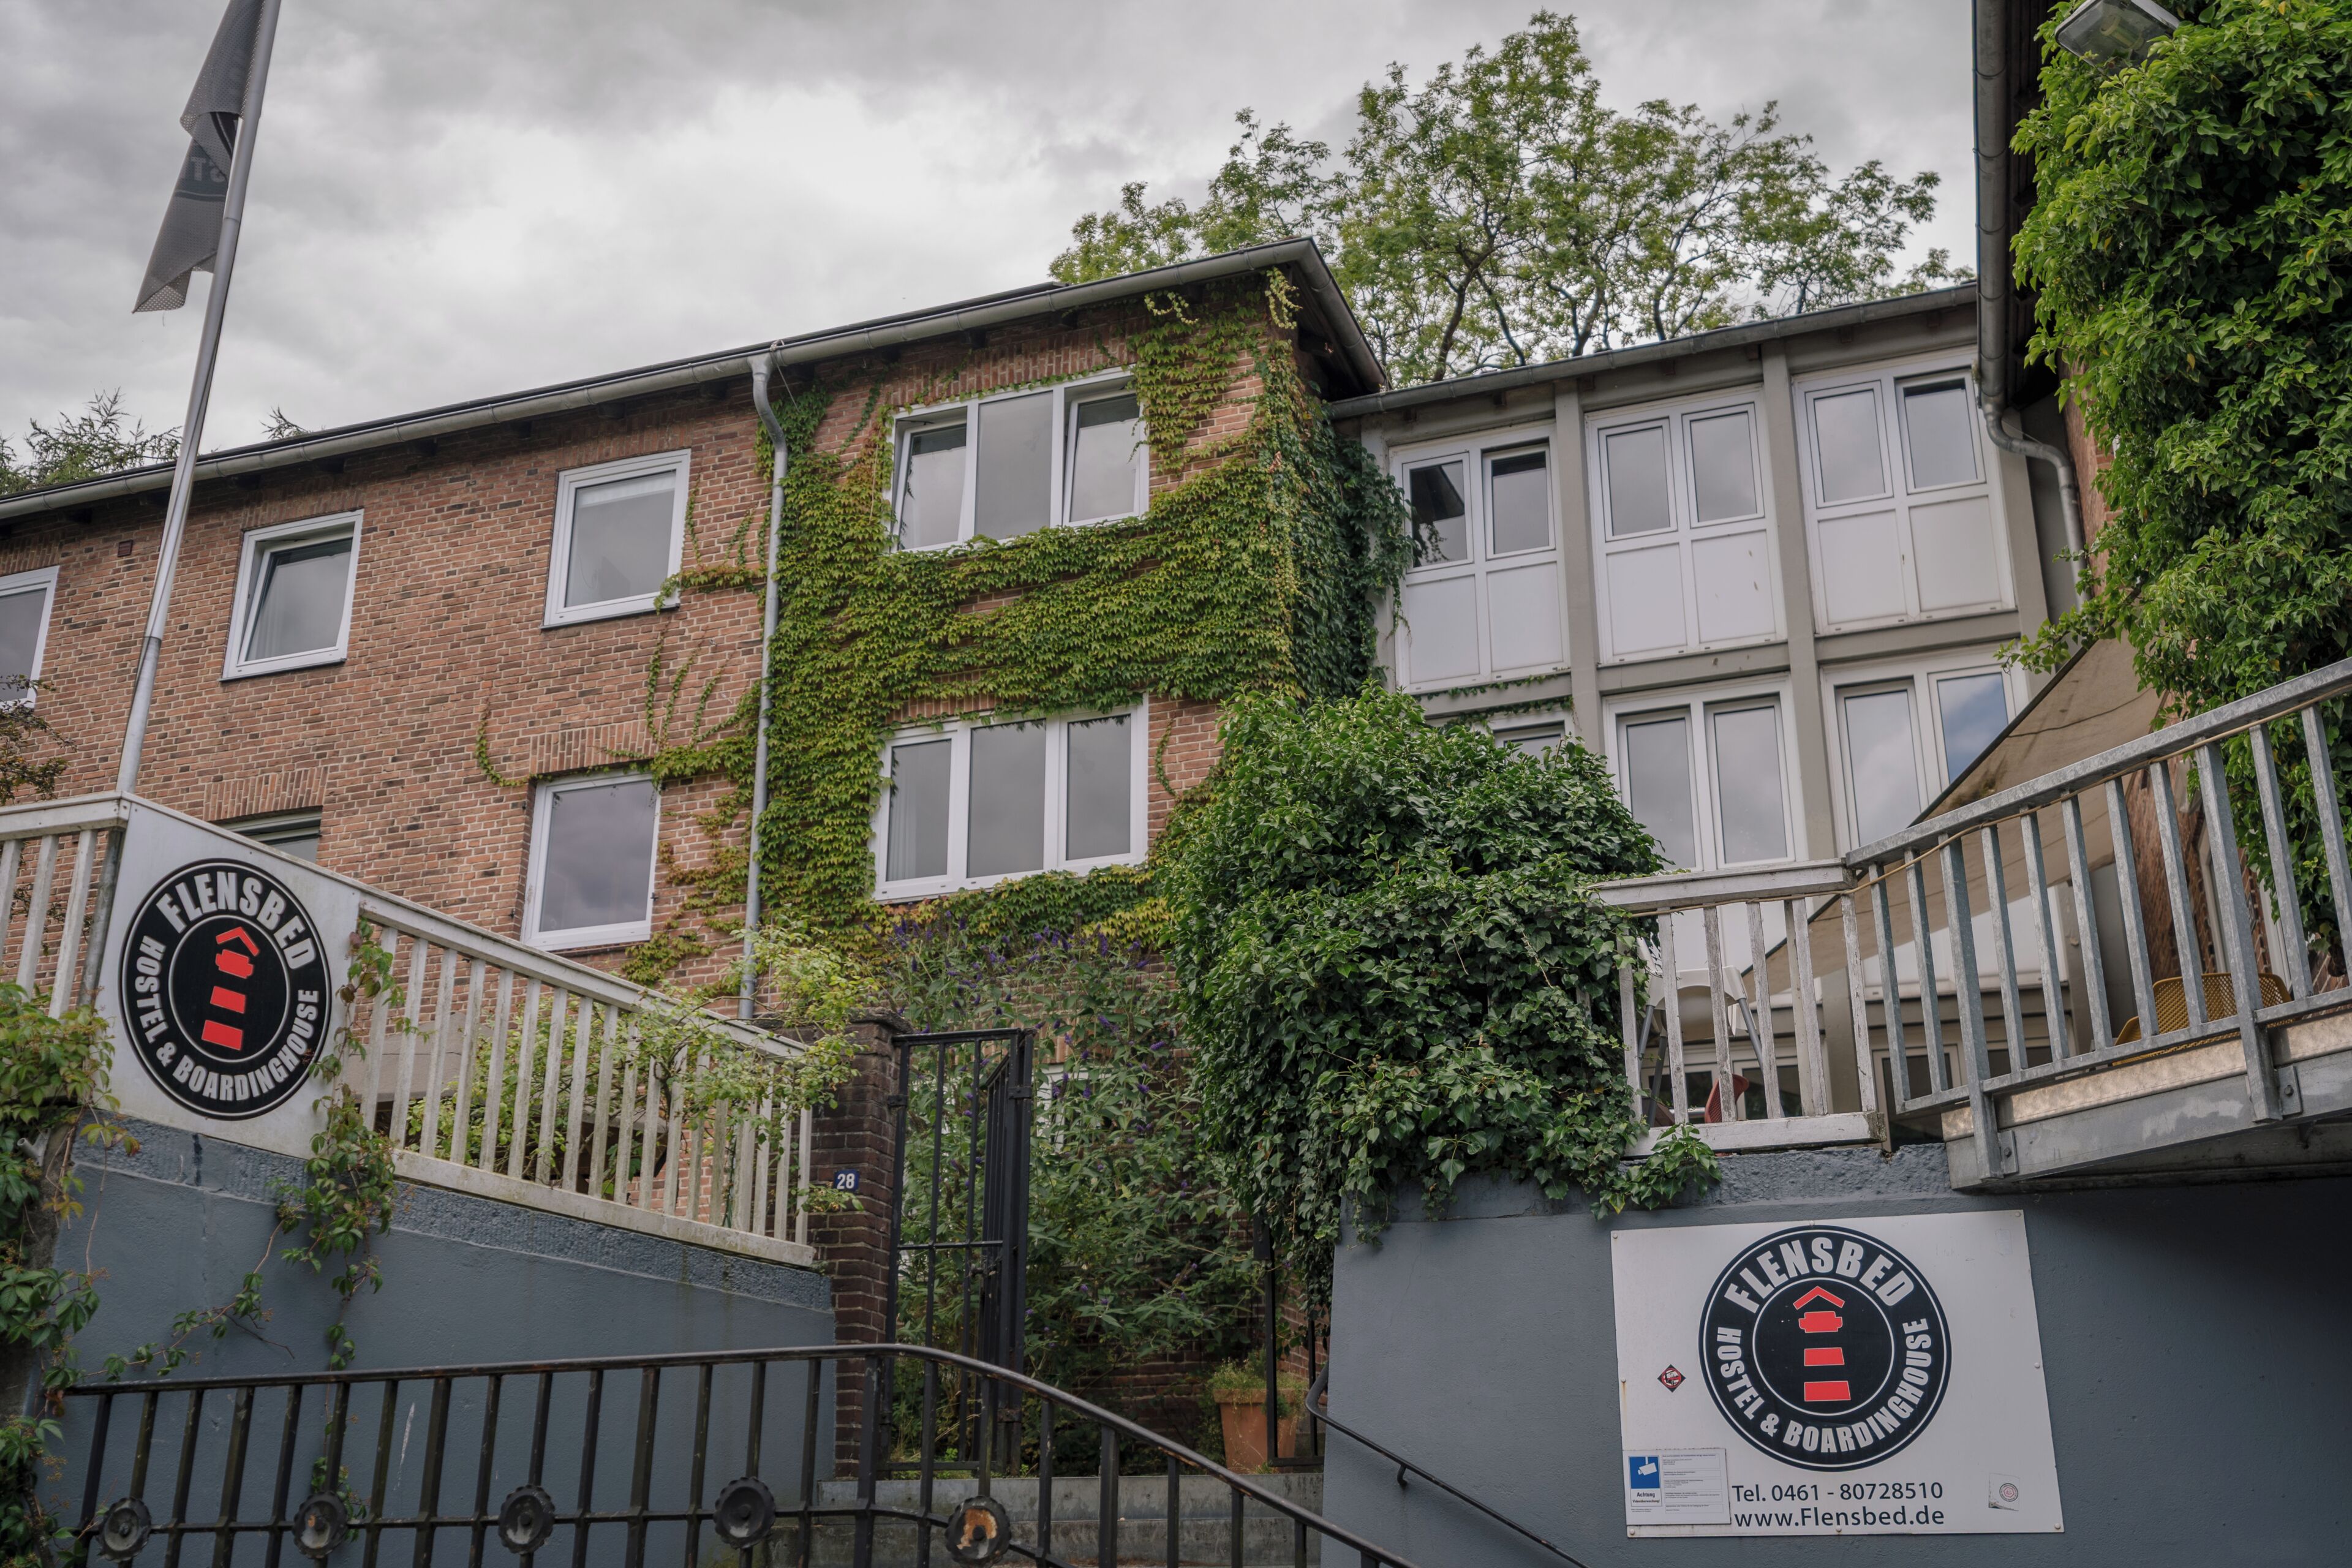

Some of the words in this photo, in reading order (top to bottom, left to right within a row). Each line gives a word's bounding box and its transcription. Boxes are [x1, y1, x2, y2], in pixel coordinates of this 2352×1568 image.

[156, 871, 317, 970] FLENSBED
[135, 935, 168, 1043] HOSTEL
[156, 1041, 177, 1068] &
[172, 989, 319, 1101] BOARDINGHOUSE
[837, 1173, 855, 1189] 28
[1724, 1237, 1915, 1314] FLENSBED
[1717, 1327, 1765, 1420] HOSTEL
[1760, 1414, 1779, 1437] &
[1783, 1317, 1932, 1453] BOARDINGHOUSE
[1732, 1485, 1766, 1502] Tel.
[1772, 1484, 1820, 1501] 0461
[1839, 1482, 1943, 1500] 80728510
[1735, 1505, 1945, 1527] www.Flensbed.de
